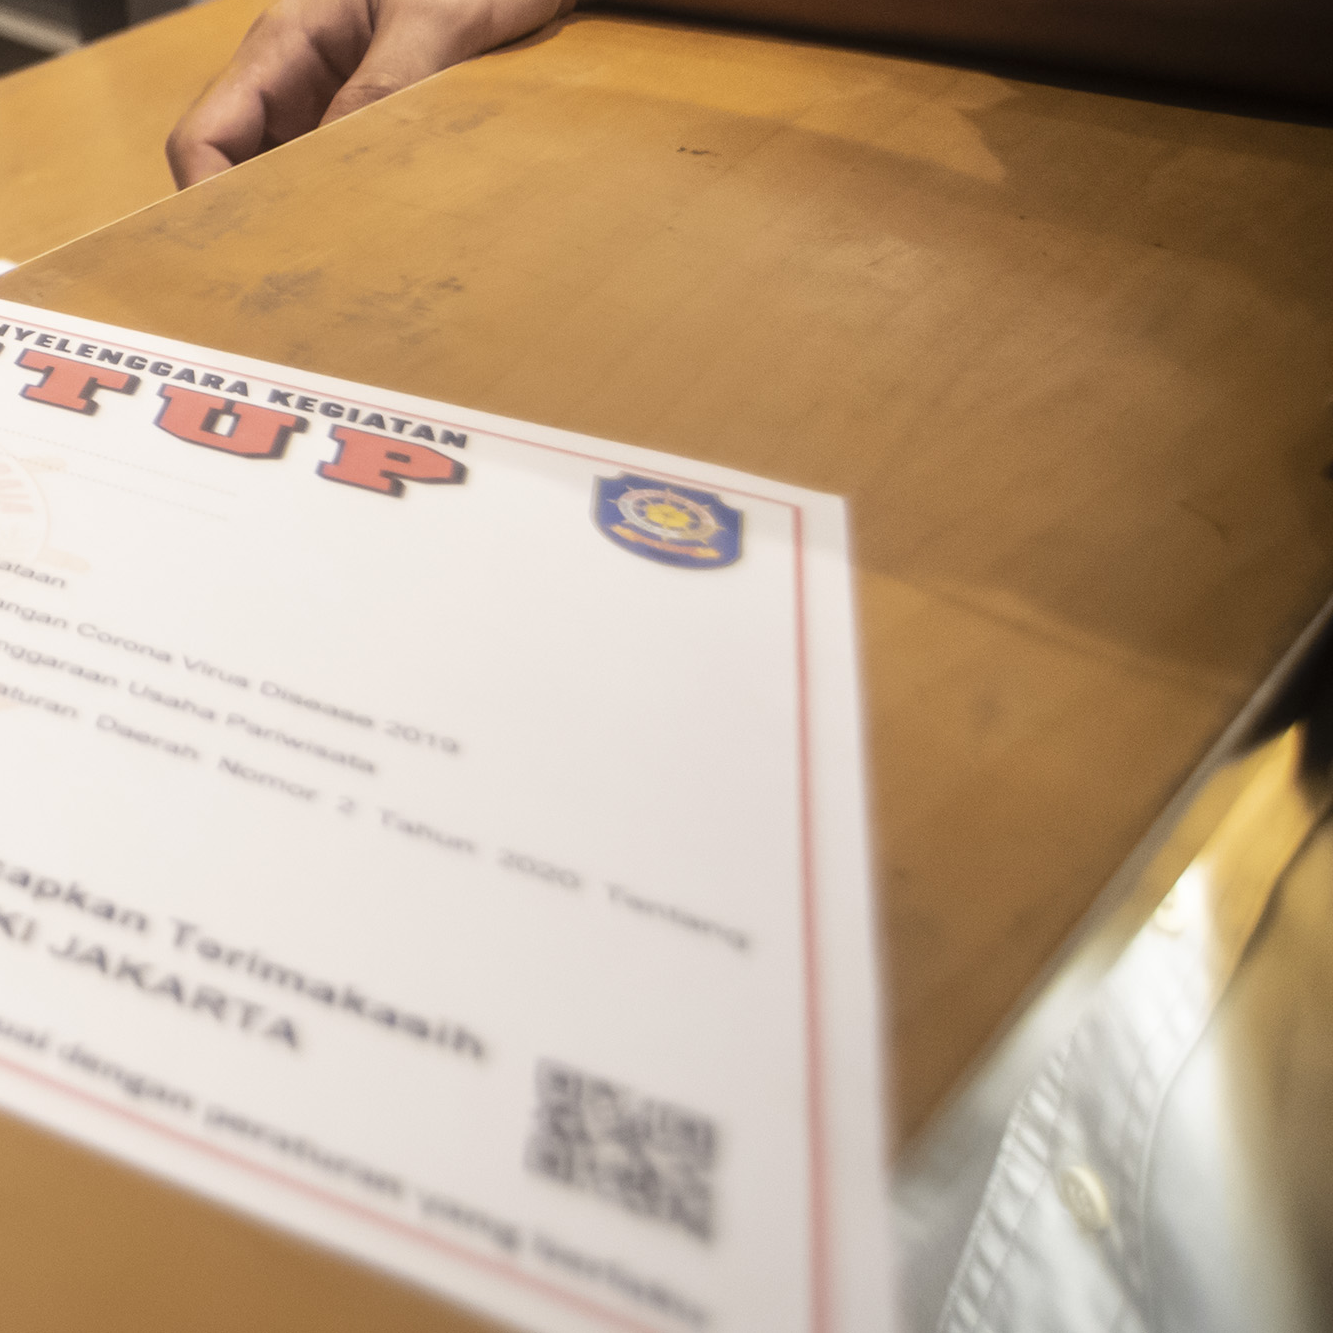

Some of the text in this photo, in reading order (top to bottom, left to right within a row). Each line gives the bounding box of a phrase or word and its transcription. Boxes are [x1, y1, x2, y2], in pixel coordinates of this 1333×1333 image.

[267, 388, 468, 448] KEGIATAN
[76, 622, 172, 664] Corona
[183, 656, 249, 688] Virus
[259, 681, 374, 727] Disease
[383, 721, 460, 754] 2019
[128, 680, 216, 722] Usaha
[226, 712, 377, 775] Pariwisata
[95, 714, 200, 761] Daerah
[217, 756, 319, 802] Nomor
[379, 808, 477, 854] Tahun
[48, 934, 300, 1050] JAKARTA
[169, 918, 488, 1062] Terimakasih
